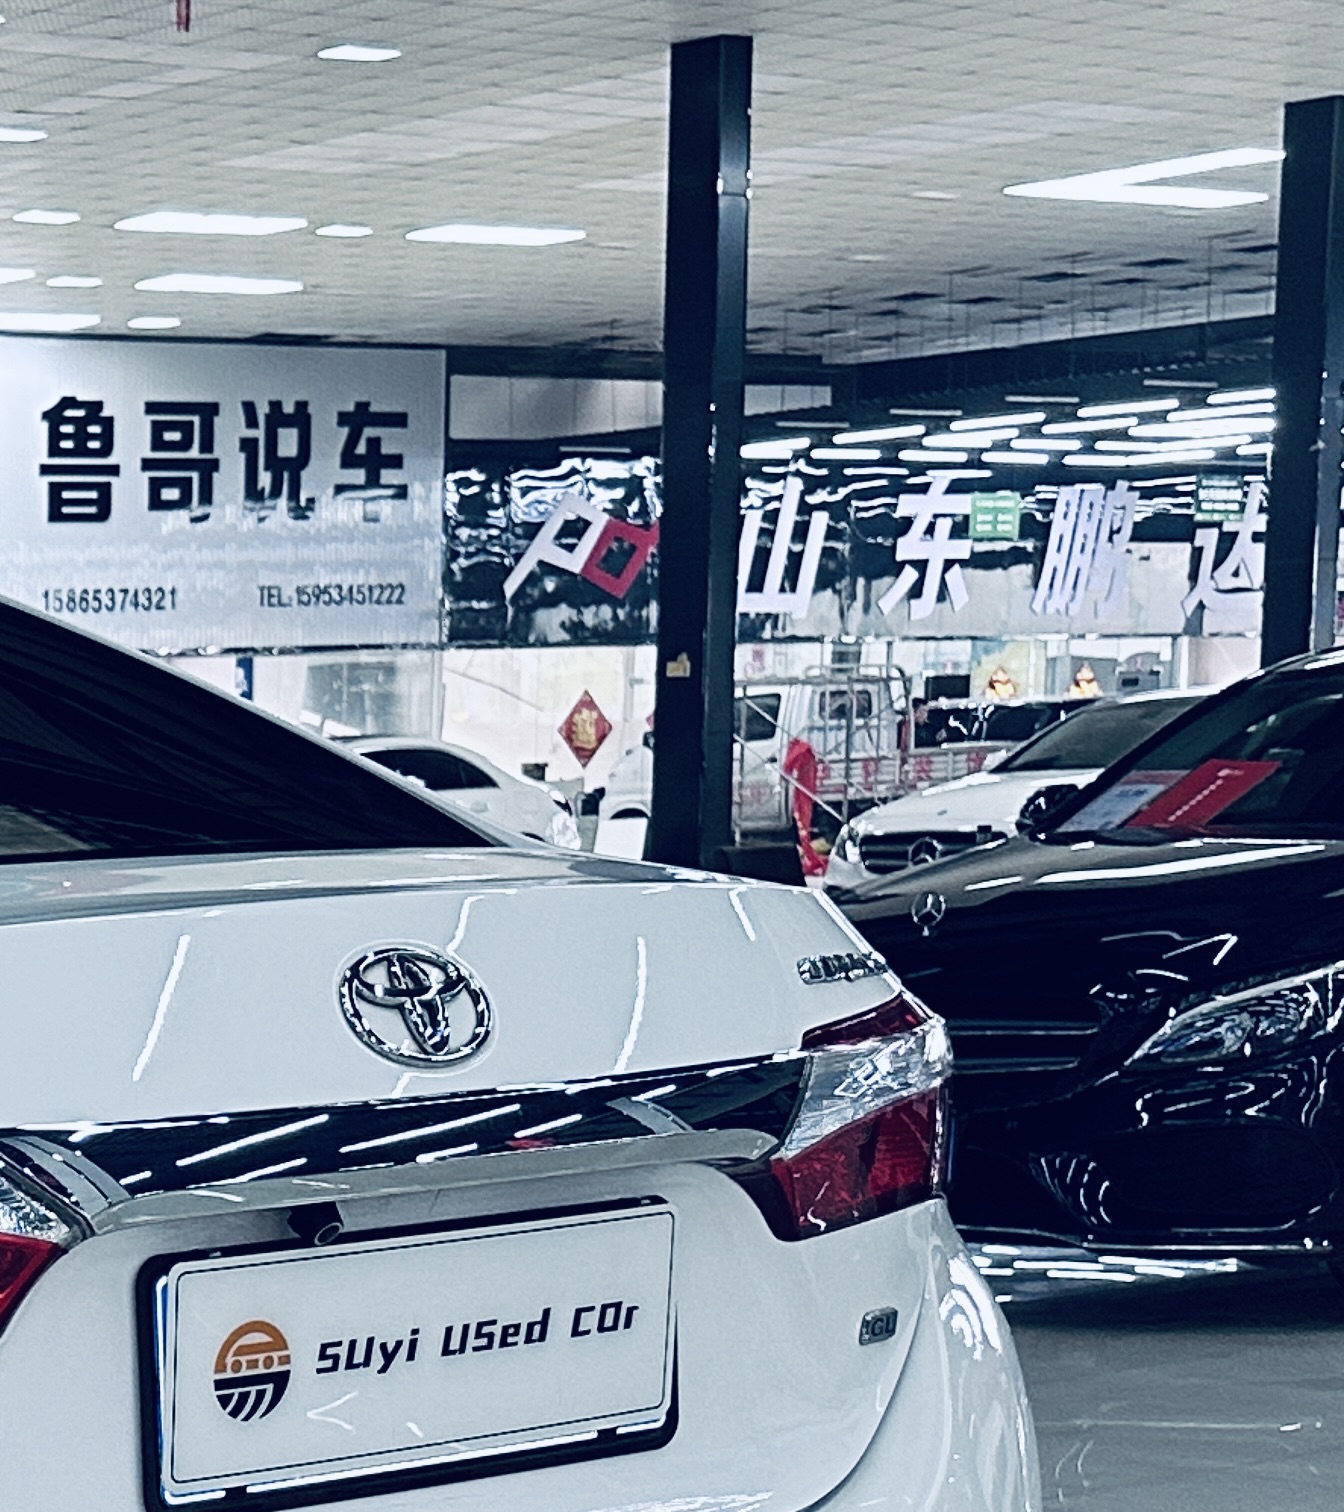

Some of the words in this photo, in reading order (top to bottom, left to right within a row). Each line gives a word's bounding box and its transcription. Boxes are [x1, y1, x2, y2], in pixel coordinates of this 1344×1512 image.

[39, 395, 408, 523] 鲁哥说车
[42, 585, 177, 613] 15865374321
